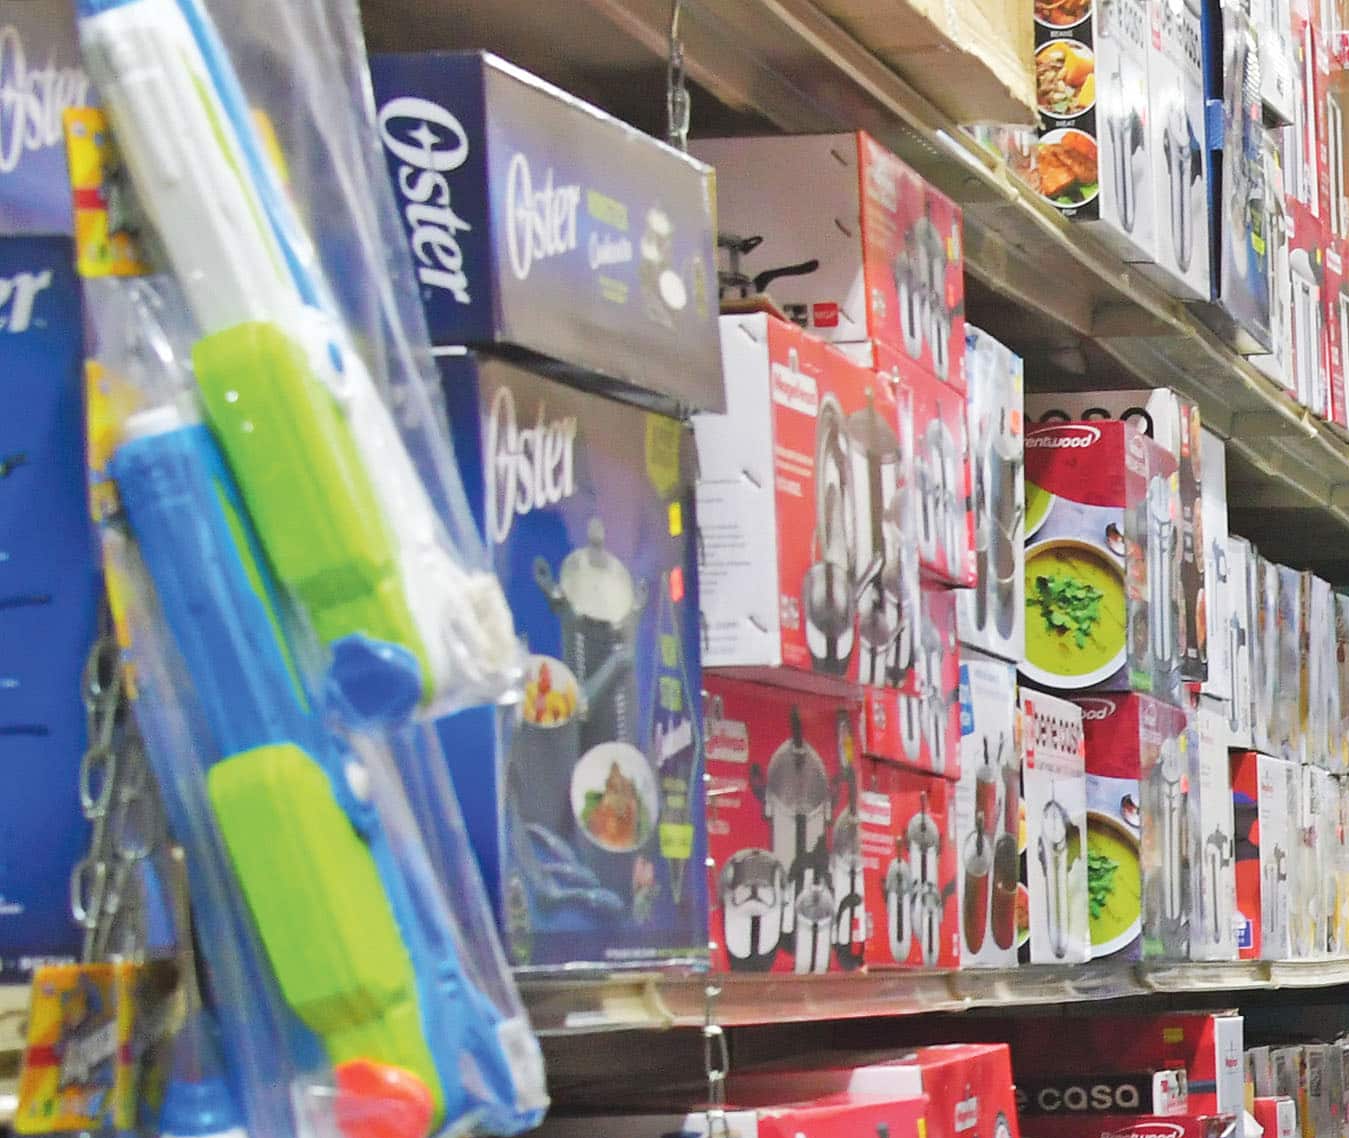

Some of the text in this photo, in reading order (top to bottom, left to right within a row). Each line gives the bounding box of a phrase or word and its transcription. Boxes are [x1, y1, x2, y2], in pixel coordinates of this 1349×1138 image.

[379, 97, 470, 303] Oster
[507, 153, 580, 280] Oster
[485, 387, 577, 542] Oster
[1024, 427, 1098, 448] rentwood
[1038, 1084, 1140, 1111] casa
